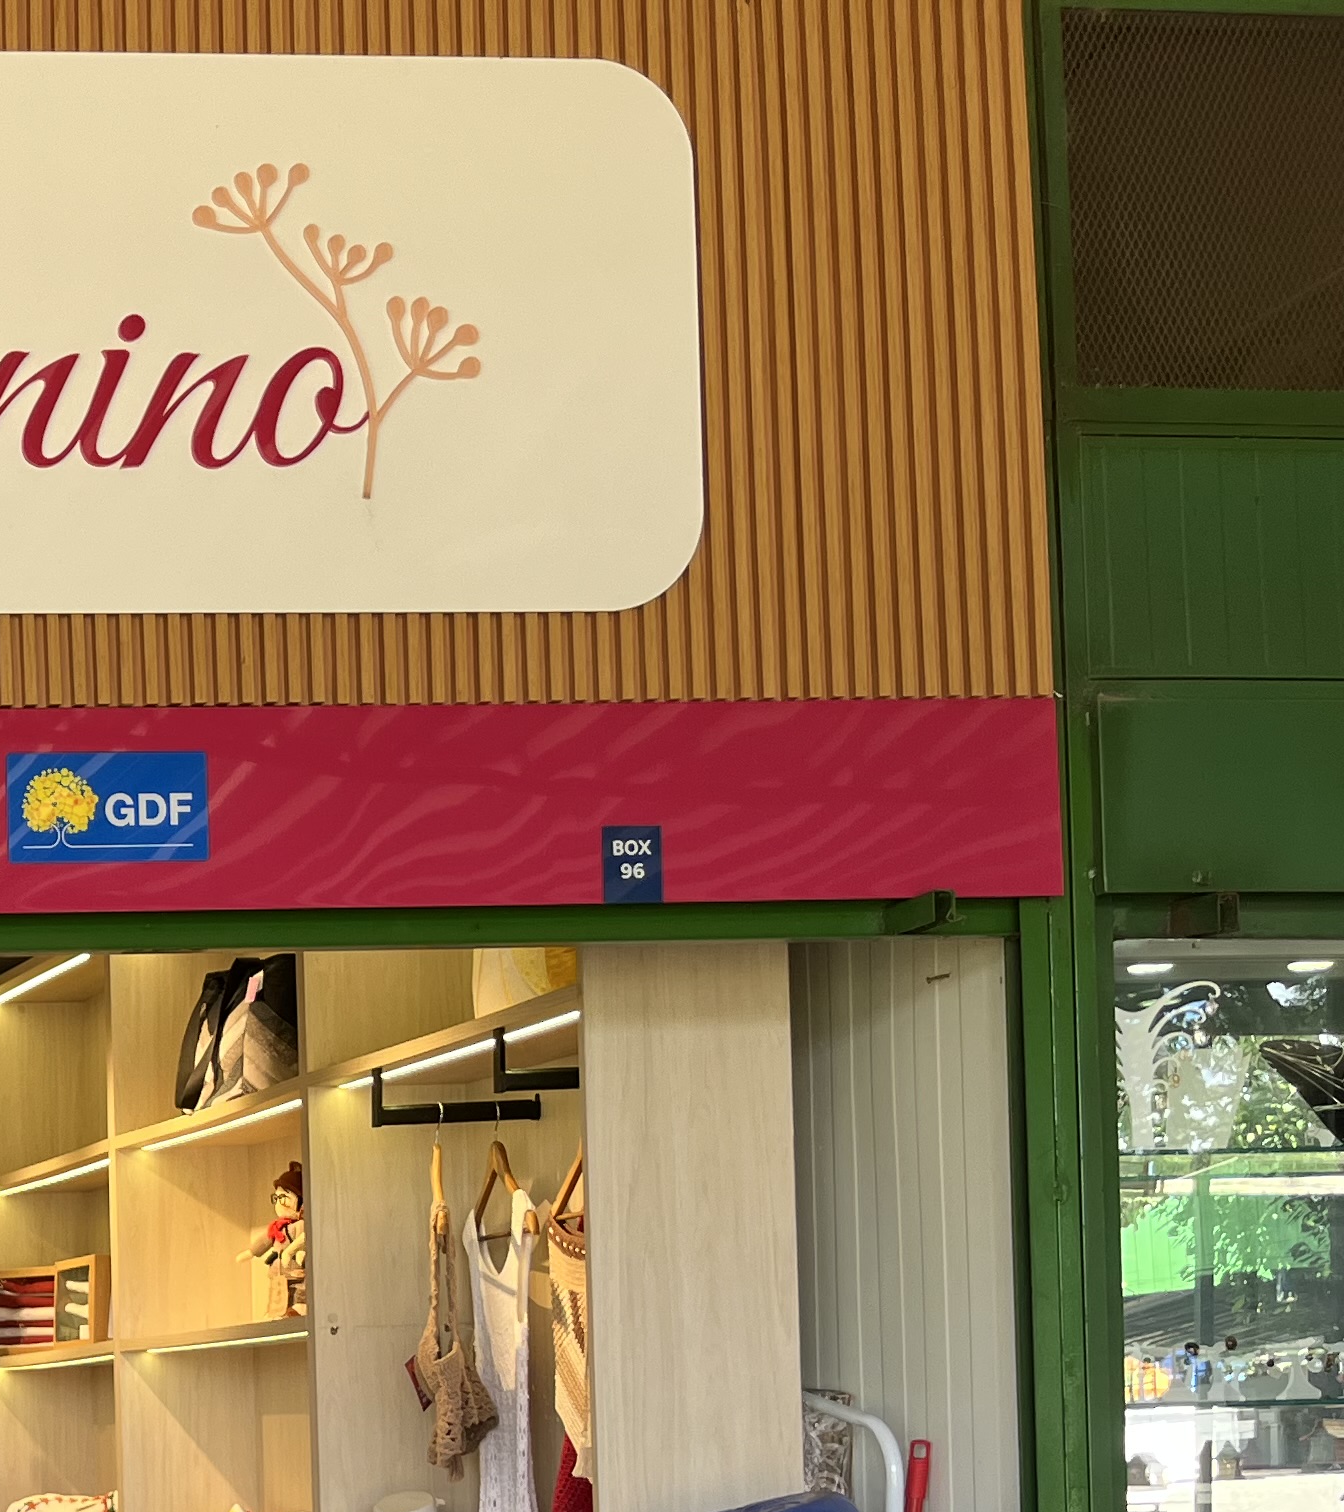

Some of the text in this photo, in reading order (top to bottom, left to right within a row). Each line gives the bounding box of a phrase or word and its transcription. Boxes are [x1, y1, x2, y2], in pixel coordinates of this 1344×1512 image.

[104, 792, 194, 827] GDF
[612, 839, 652, 856] BOX
[620, 863, 645, 879] 96
